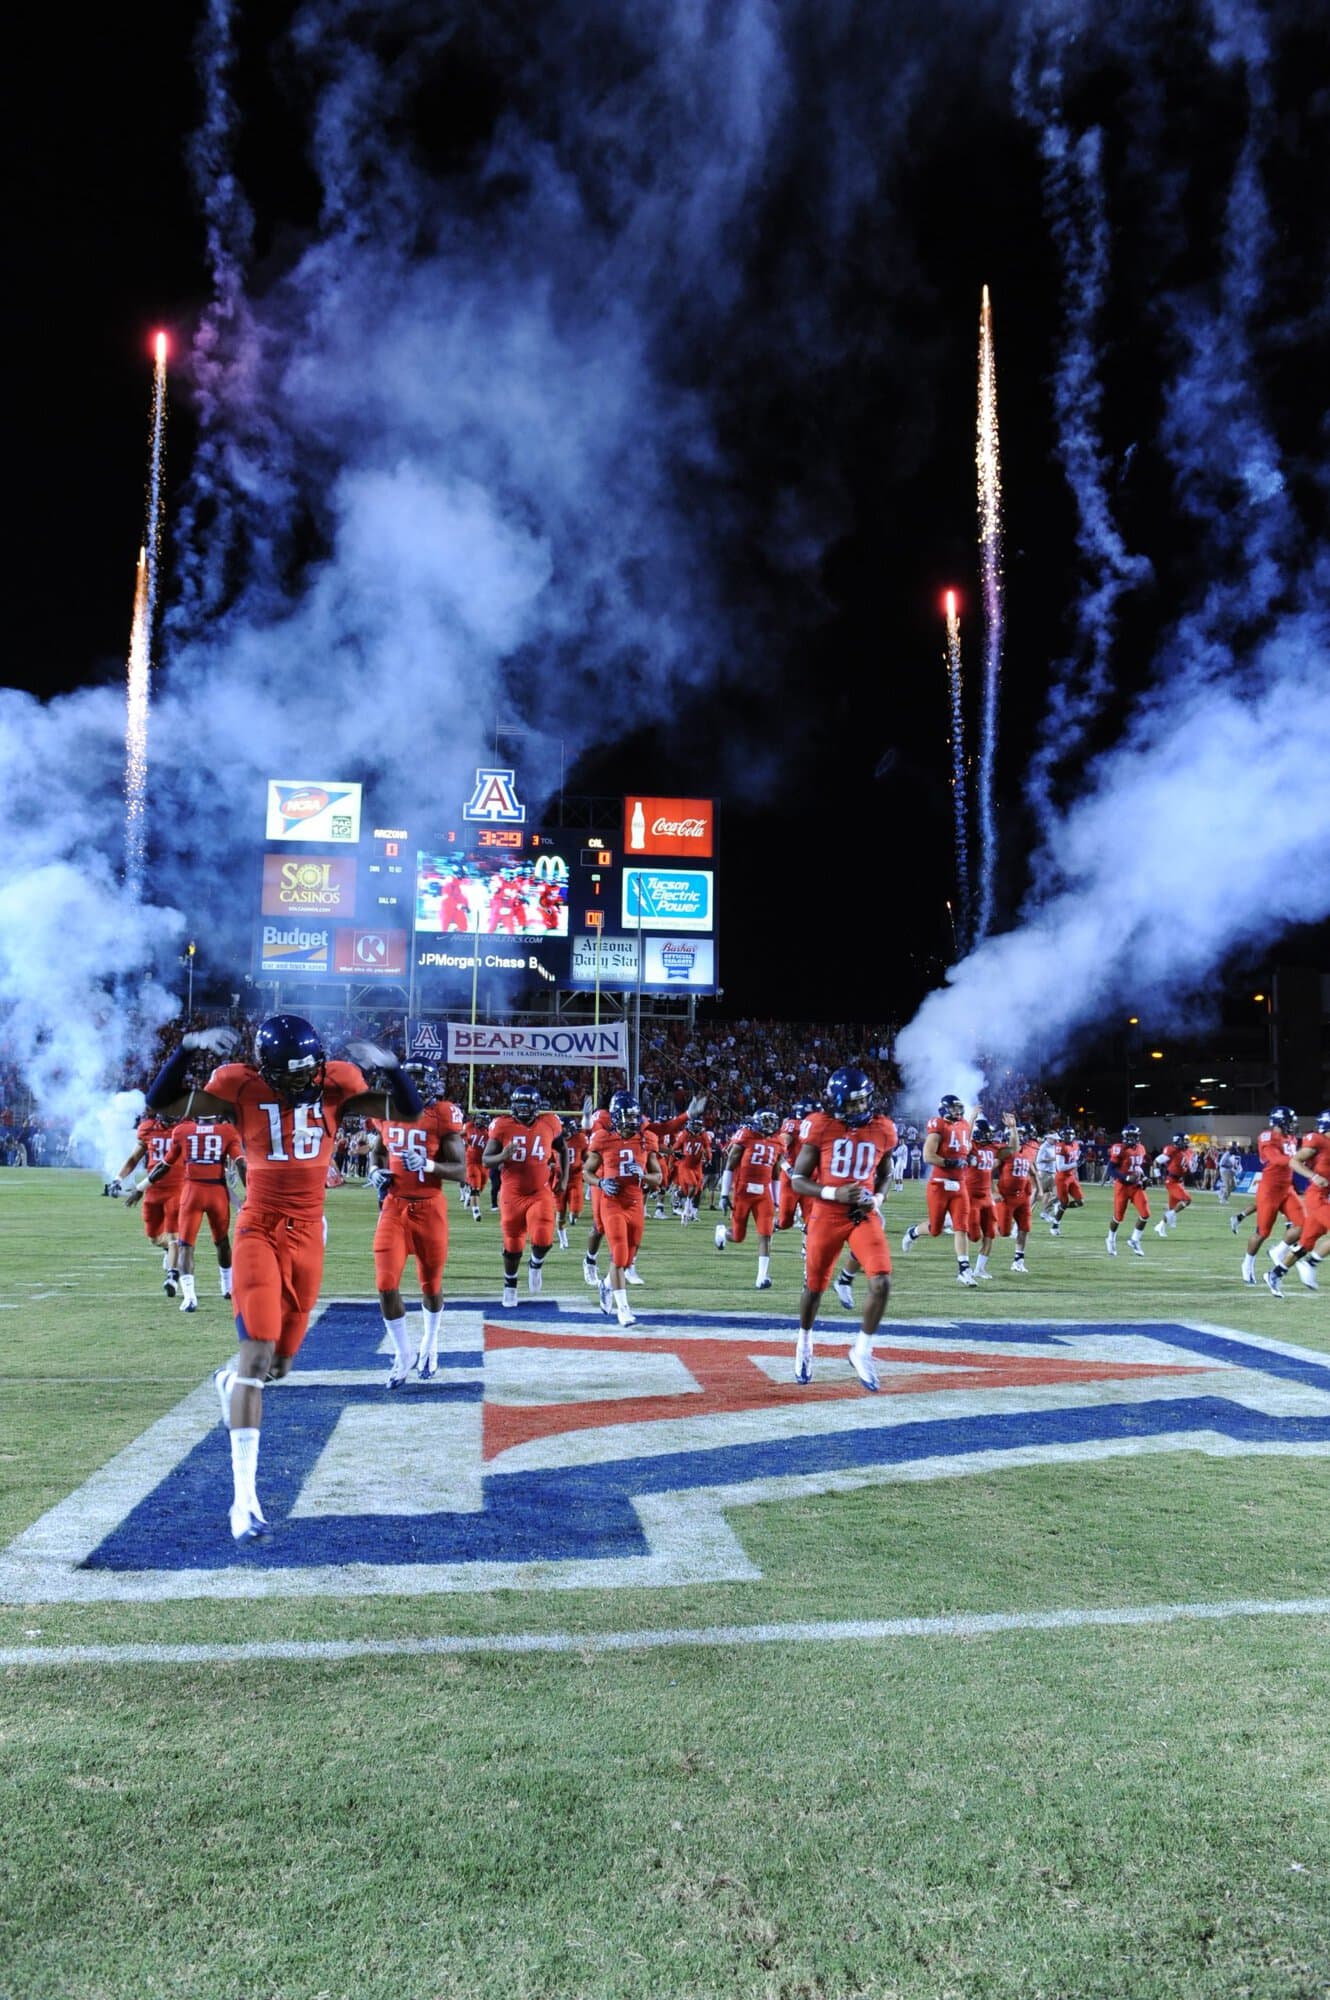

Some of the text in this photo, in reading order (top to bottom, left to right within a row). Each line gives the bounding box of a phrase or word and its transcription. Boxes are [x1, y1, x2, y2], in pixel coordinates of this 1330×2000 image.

[463, 768, 526, 823] A
[652, 817, 707, 837] Coca-Cola
[478, 830, 521, 848] 3:29
[532, 834, 540, 846] 3
[280, 862, 340, 892] SOL
[647, 877, 690, 890] Tucson
[280, 890, 341, 904] CASINOS
[652, 889, 701, 902] Electric
[656, 900, 700, 912] Power
[263, 926, 328, 950] Budget
[418, 953, 482, 969] JPMorgan
[485, 955, 526, 969] Chase
[573, 953, 608, 969] Daiy
[612, 954, 638, 967] Star
[412, 1023, 443, 1050] A
[531, 1032, 619, 1053] DOWN
[259, 1101, 324, 1160] 16
[187, 1134, 222, 1162] 18
[388, 1127, 427, 1158] 26
[619, 1149, 635, 1176] 2
[750, 1143, 775, 1167] 21
[830, 1138, 876, 1180] 80
